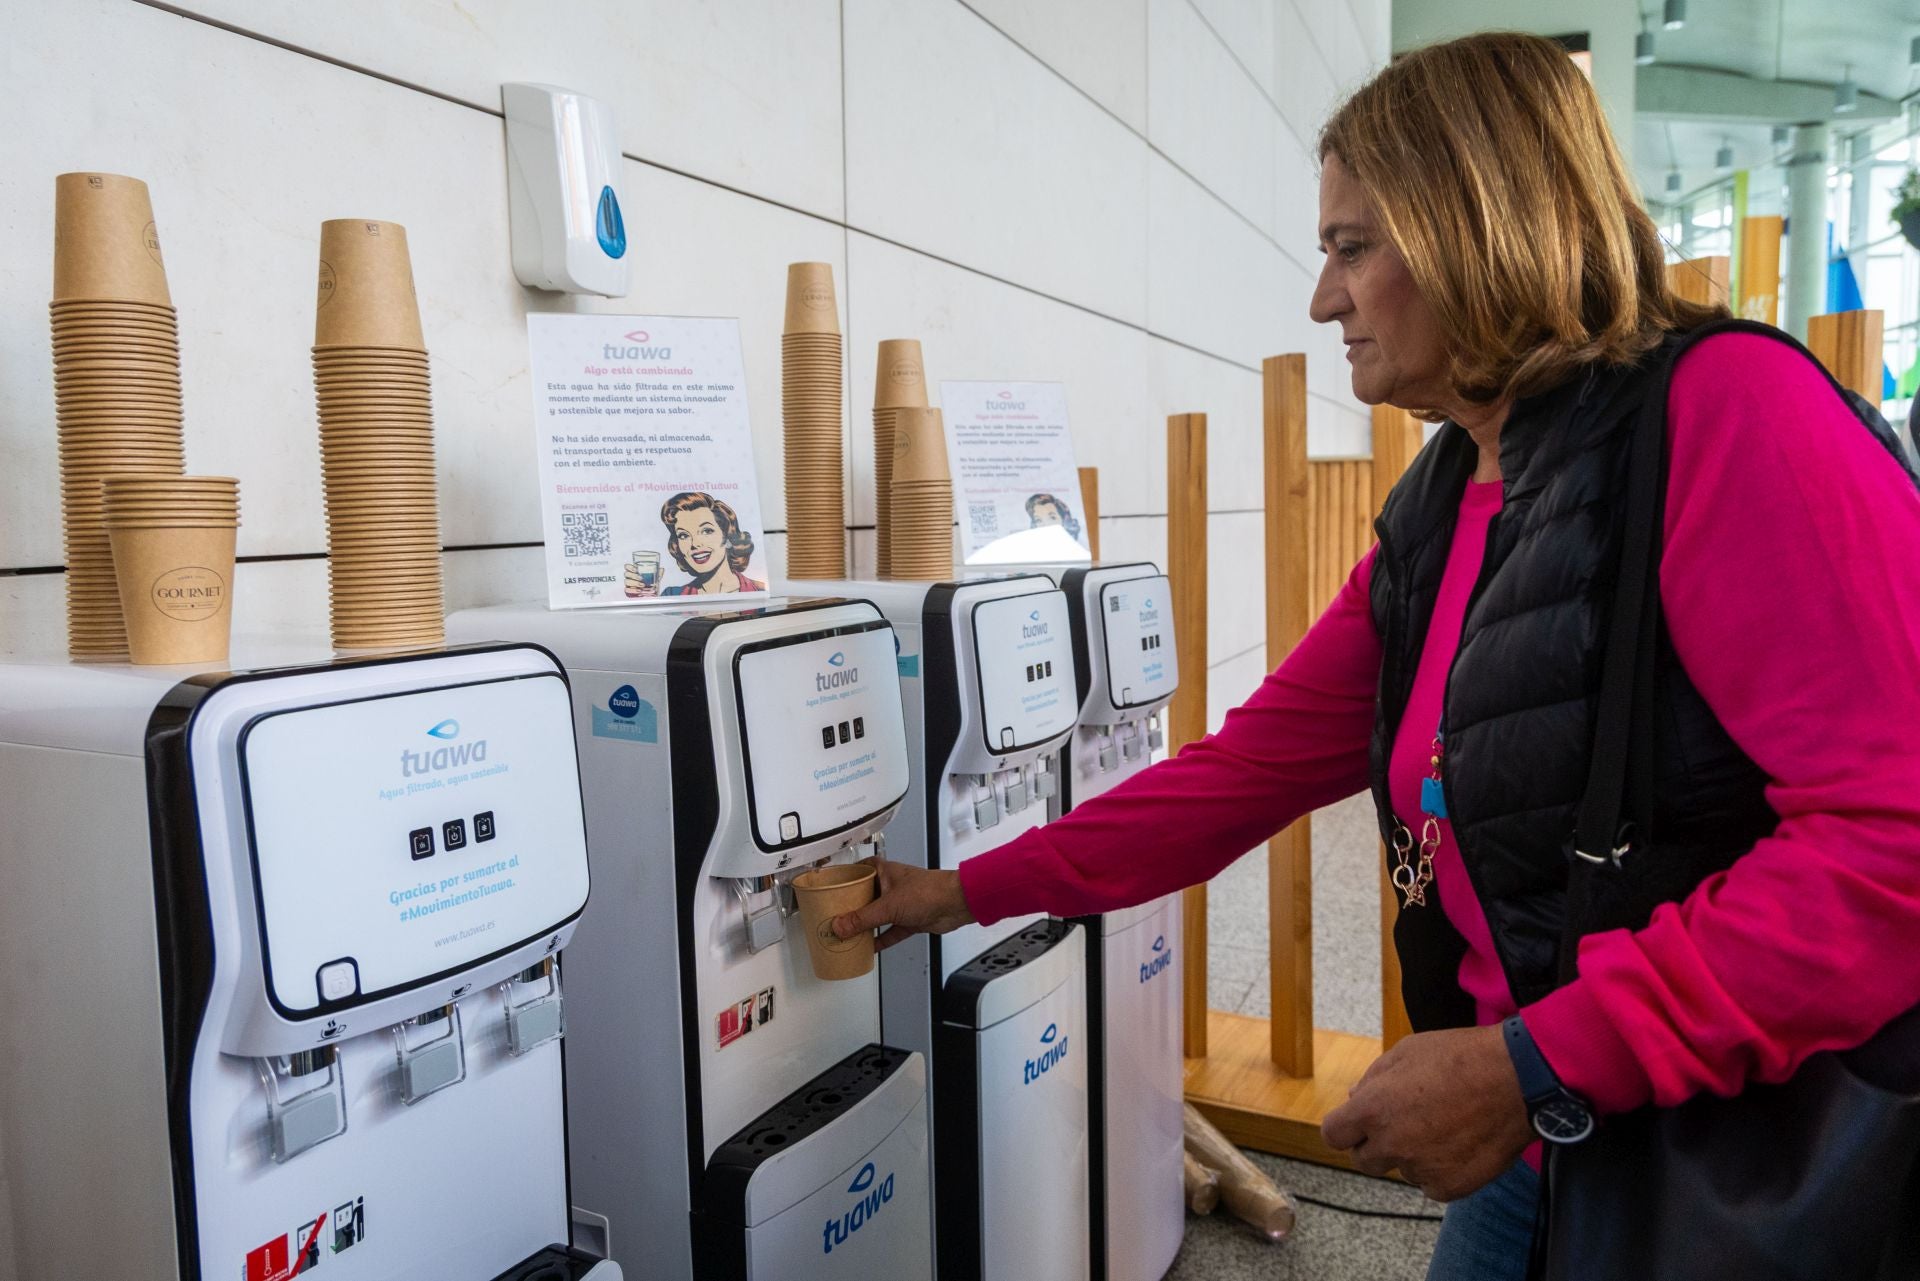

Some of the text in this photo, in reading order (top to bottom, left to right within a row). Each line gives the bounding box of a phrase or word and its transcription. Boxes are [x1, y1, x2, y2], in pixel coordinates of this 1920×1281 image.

[603, 343, 672, 360] tuawa
[584, 365, 608, 376] Algo
[636, 366, 693, 376] cambiando
[547, 382, 566, 391] Esta
[571, 384, 593, 392] agua
[598, 383, 609, 391] ha
[614, 383, 631, 391] sido
[635, 383, 668, 392] filtrada
[548, 395, 590, 403] momento
[986, 400, 1025, 410] tuawa
[558, 406, 602, 414] sostenible
[624, 407, 653, 416] mejora
[669, 406, 695, 414] sabor.
[552, 435, 564, 443] No
[602, 434, 645, 443] envasada,
[565, 447, 623, 456] transportada
[646, 446, 692, 455] respetuosa
[613, 459, 656, 467] ambiente.
[556, 482, 738, 494] Bienvenidos al #MovimientoTuawa
[578, 575, 616, 583] PROVINCIAS
[157, 586, 222, 599] GOURMET
[1023, 622, 1048, 639] tuawa
[816, 667, 858, 692] tuawa
[613, 698, 637, 708] tuawa
[401, 740, 487, 778] tuawa
[379, 788, 404, 800] Agua
[447, 773, 469, 786] agua
[389, 854, 519, 906] Gracias por sumarte al
[400, 877, 516, 922] #MovimientoTuawa.
[434, 920, 496, 948] www.tuawa.es
[1140, 949, 1171, 983] tuawa
[1024, 1036, 1068, 1085] tuawa
[824, 1172, 895, 1254] tuawa
